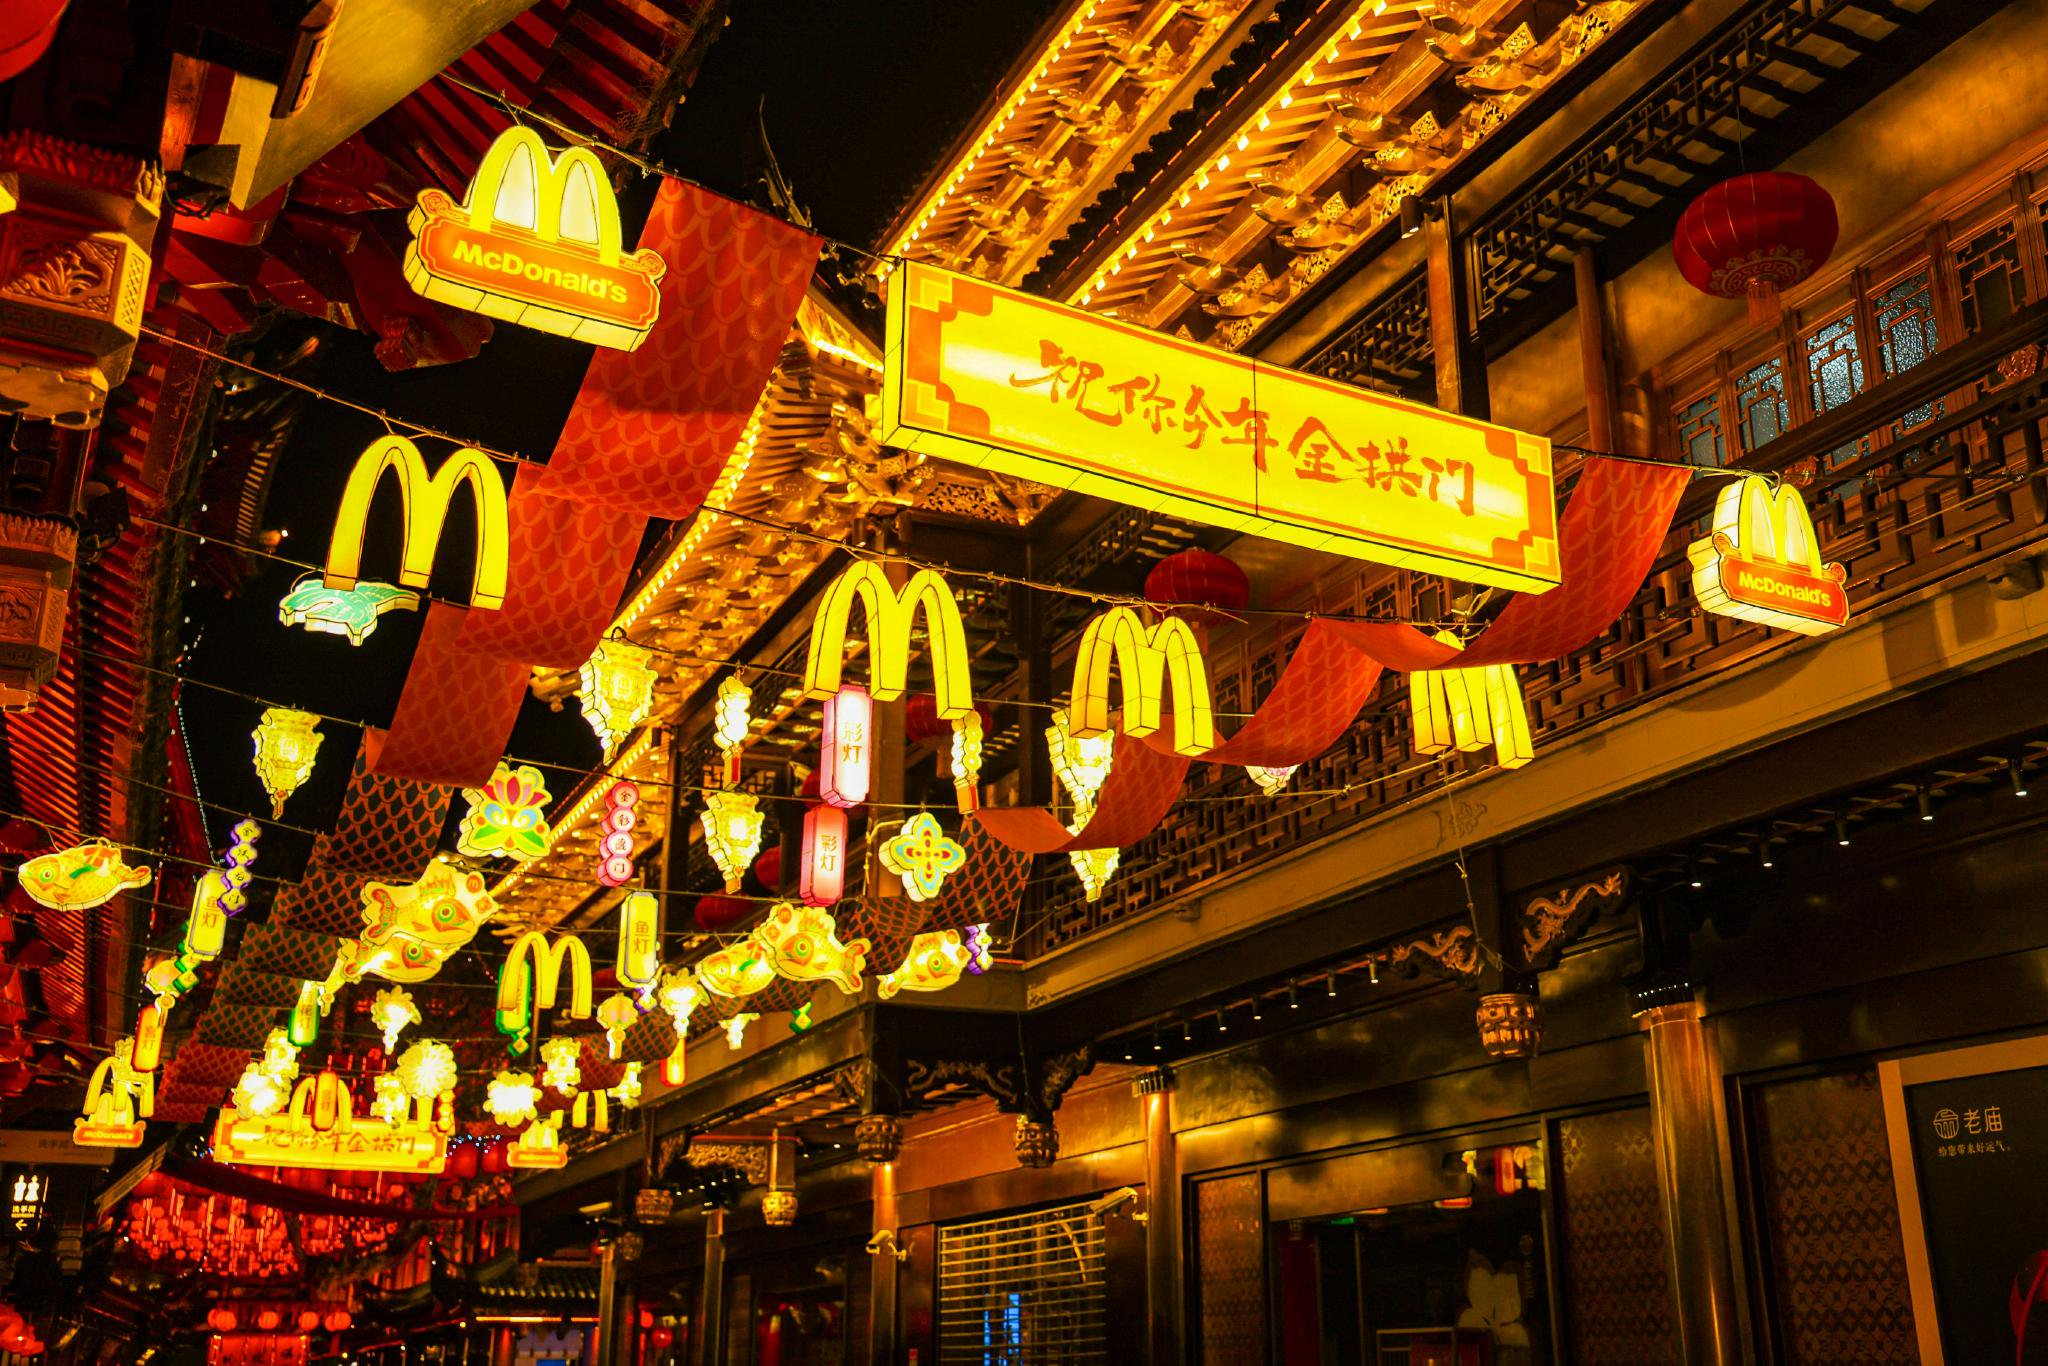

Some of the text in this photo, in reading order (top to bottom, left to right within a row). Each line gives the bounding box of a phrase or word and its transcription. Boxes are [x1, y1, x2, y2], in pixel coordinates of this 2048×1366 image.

[452, 240, 628, 304] McDonald's
[1009, 338, 1476, 518] 祝你今年金拱门
[1739, 571, 1831, 607] McDonald's
[842, 722, 863, 765] 彩灯
[820, 834, 837, 872] 彩灯
[202, 896, 220, 930] 鱼灯
[633, 920, 650, 955] 鱼灯
[1963, 1105, 2003, 1134] 老庙
